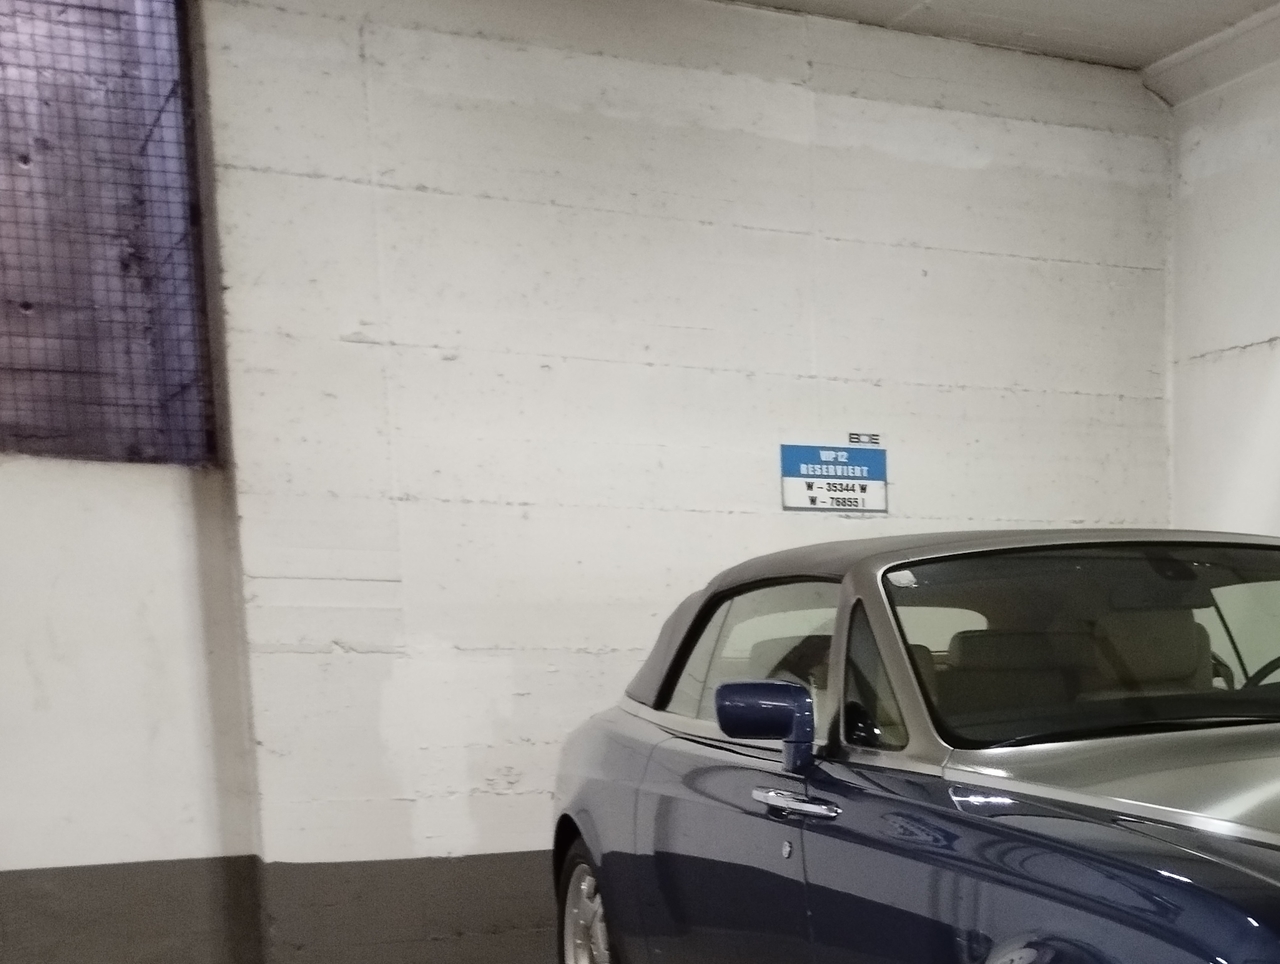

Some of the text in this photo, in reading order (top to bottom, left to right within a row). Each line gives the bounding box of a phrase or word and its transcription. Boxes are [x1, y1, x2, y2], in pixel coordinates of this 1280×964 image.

[800, 463, 869, 478] RESERVIERT
[805, 481, 815, 491] W
[826, 482, 856, 493] 35344
[858, 483, 868, 494] W
[808, 495, 818, 506] W
[829, 496, 859, 508] 76855
